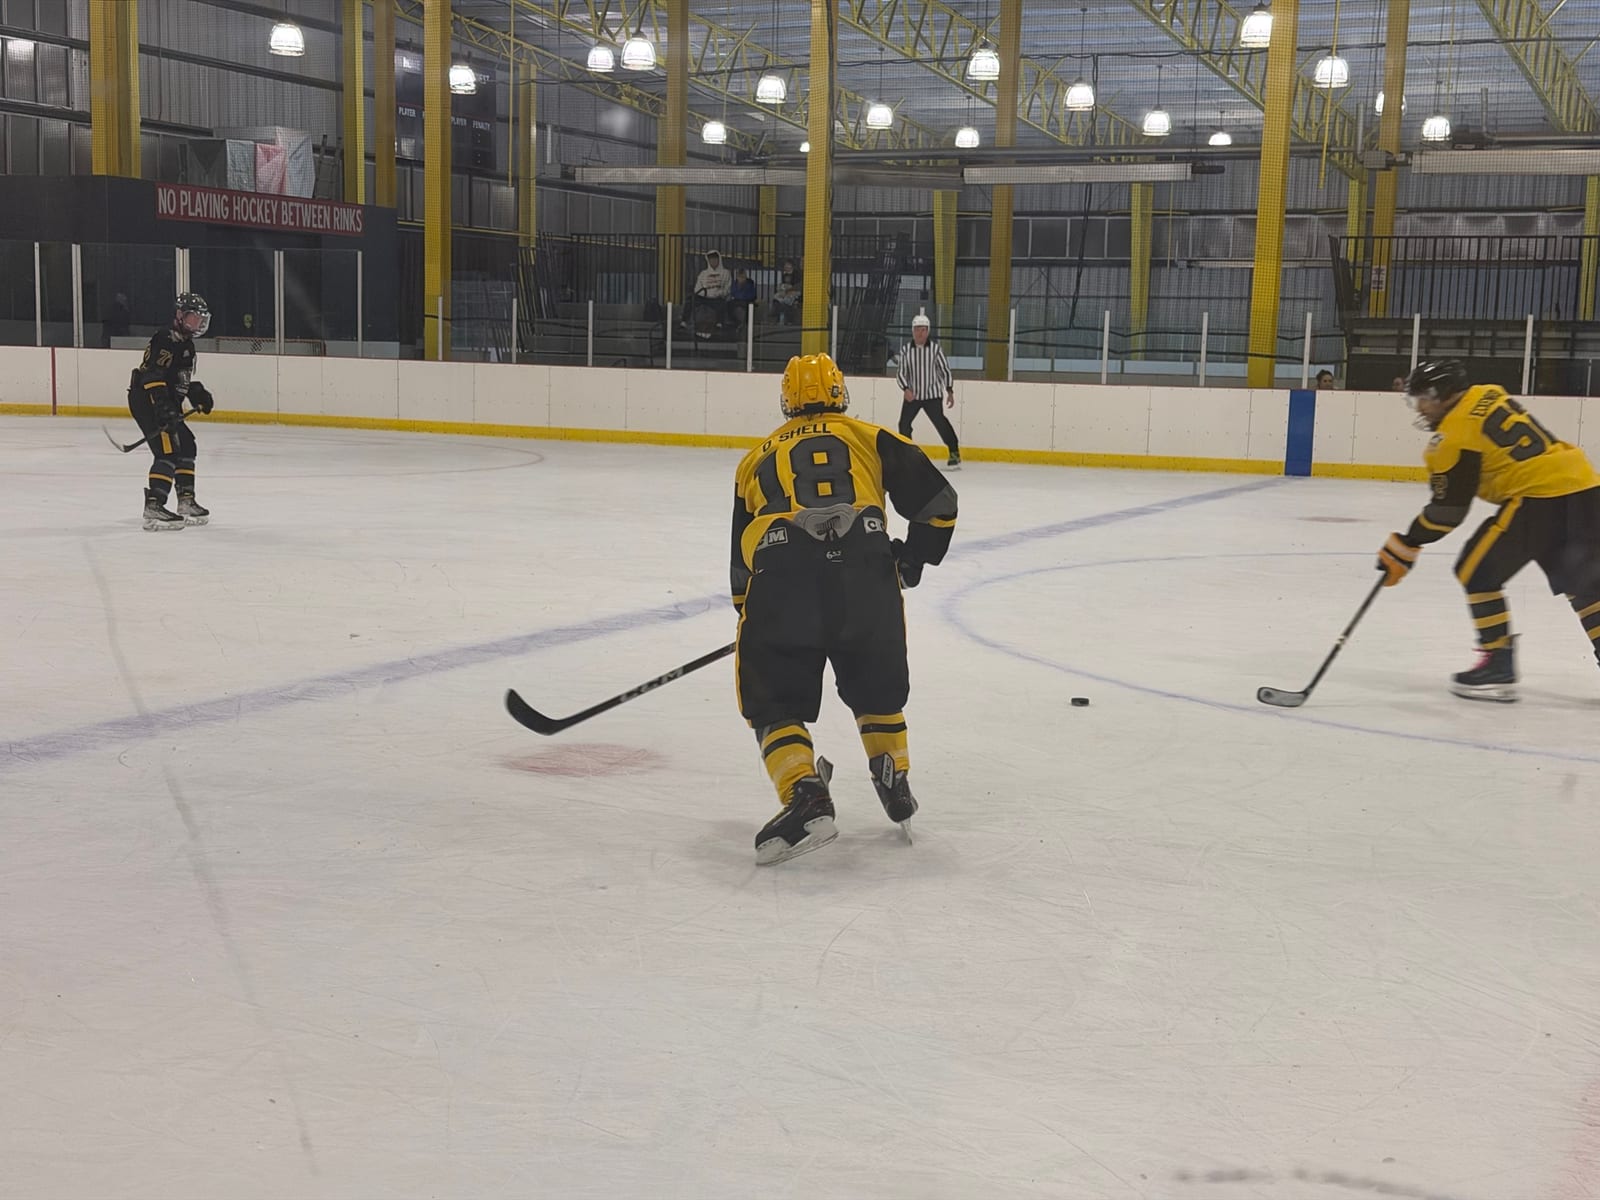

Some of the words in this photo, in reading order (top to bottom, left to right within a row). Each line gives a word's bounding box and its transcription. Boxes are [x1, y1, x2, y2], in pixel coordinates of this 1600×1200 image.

[398, 106, 416, 118] PLAYER
[473, 120, 491, 131] PENALTY
[158, 188, 176, 215] NO
[180, 190, 229, 222] PLAYING
[232, 196, 278, 225] HOCKEY
[281, 201, 330, 230] BETWEEN
[333, 206, 363, 233] RINKS
[778, 423, 831, 442] SHELL
[753, 434, 857, 516] 18
